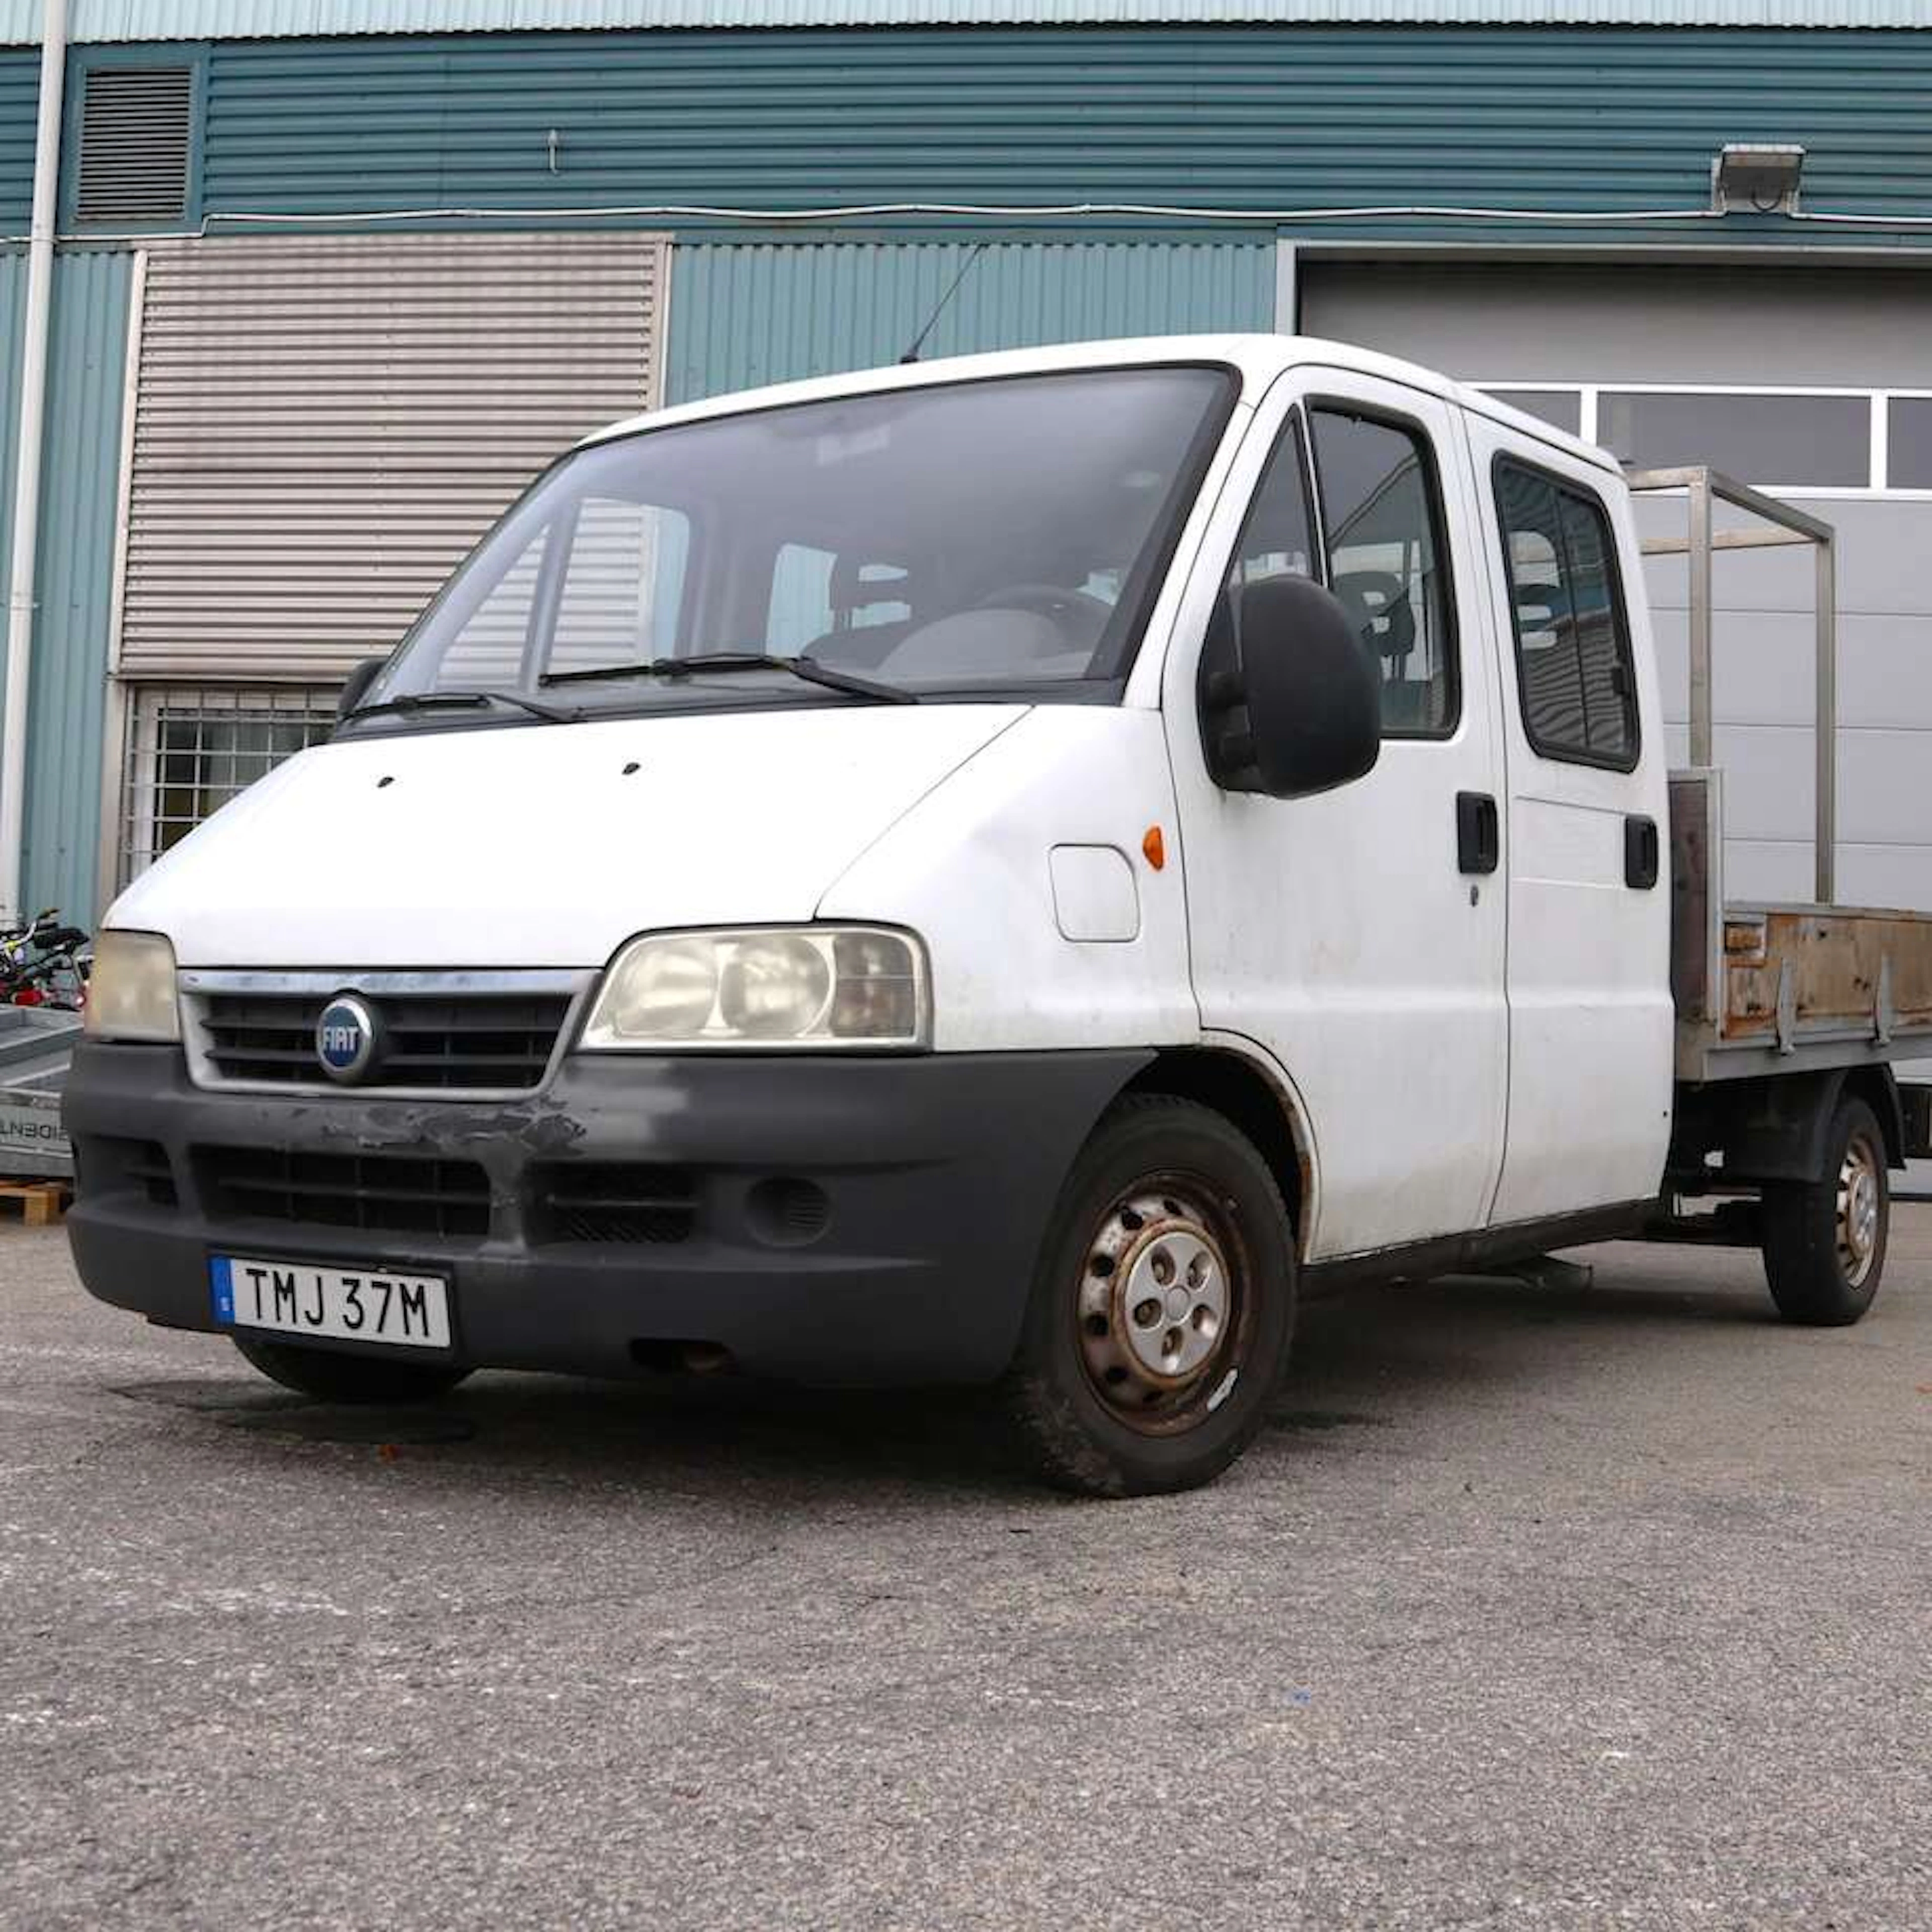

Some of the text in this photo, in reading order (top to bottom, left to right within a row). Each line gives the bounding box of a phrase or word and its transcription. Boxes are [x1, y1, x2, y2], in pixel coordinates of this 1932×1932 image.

[323, 1025, 359, 1052] FIAT
[246, 1268, 429, 1337] TMJ 37M
